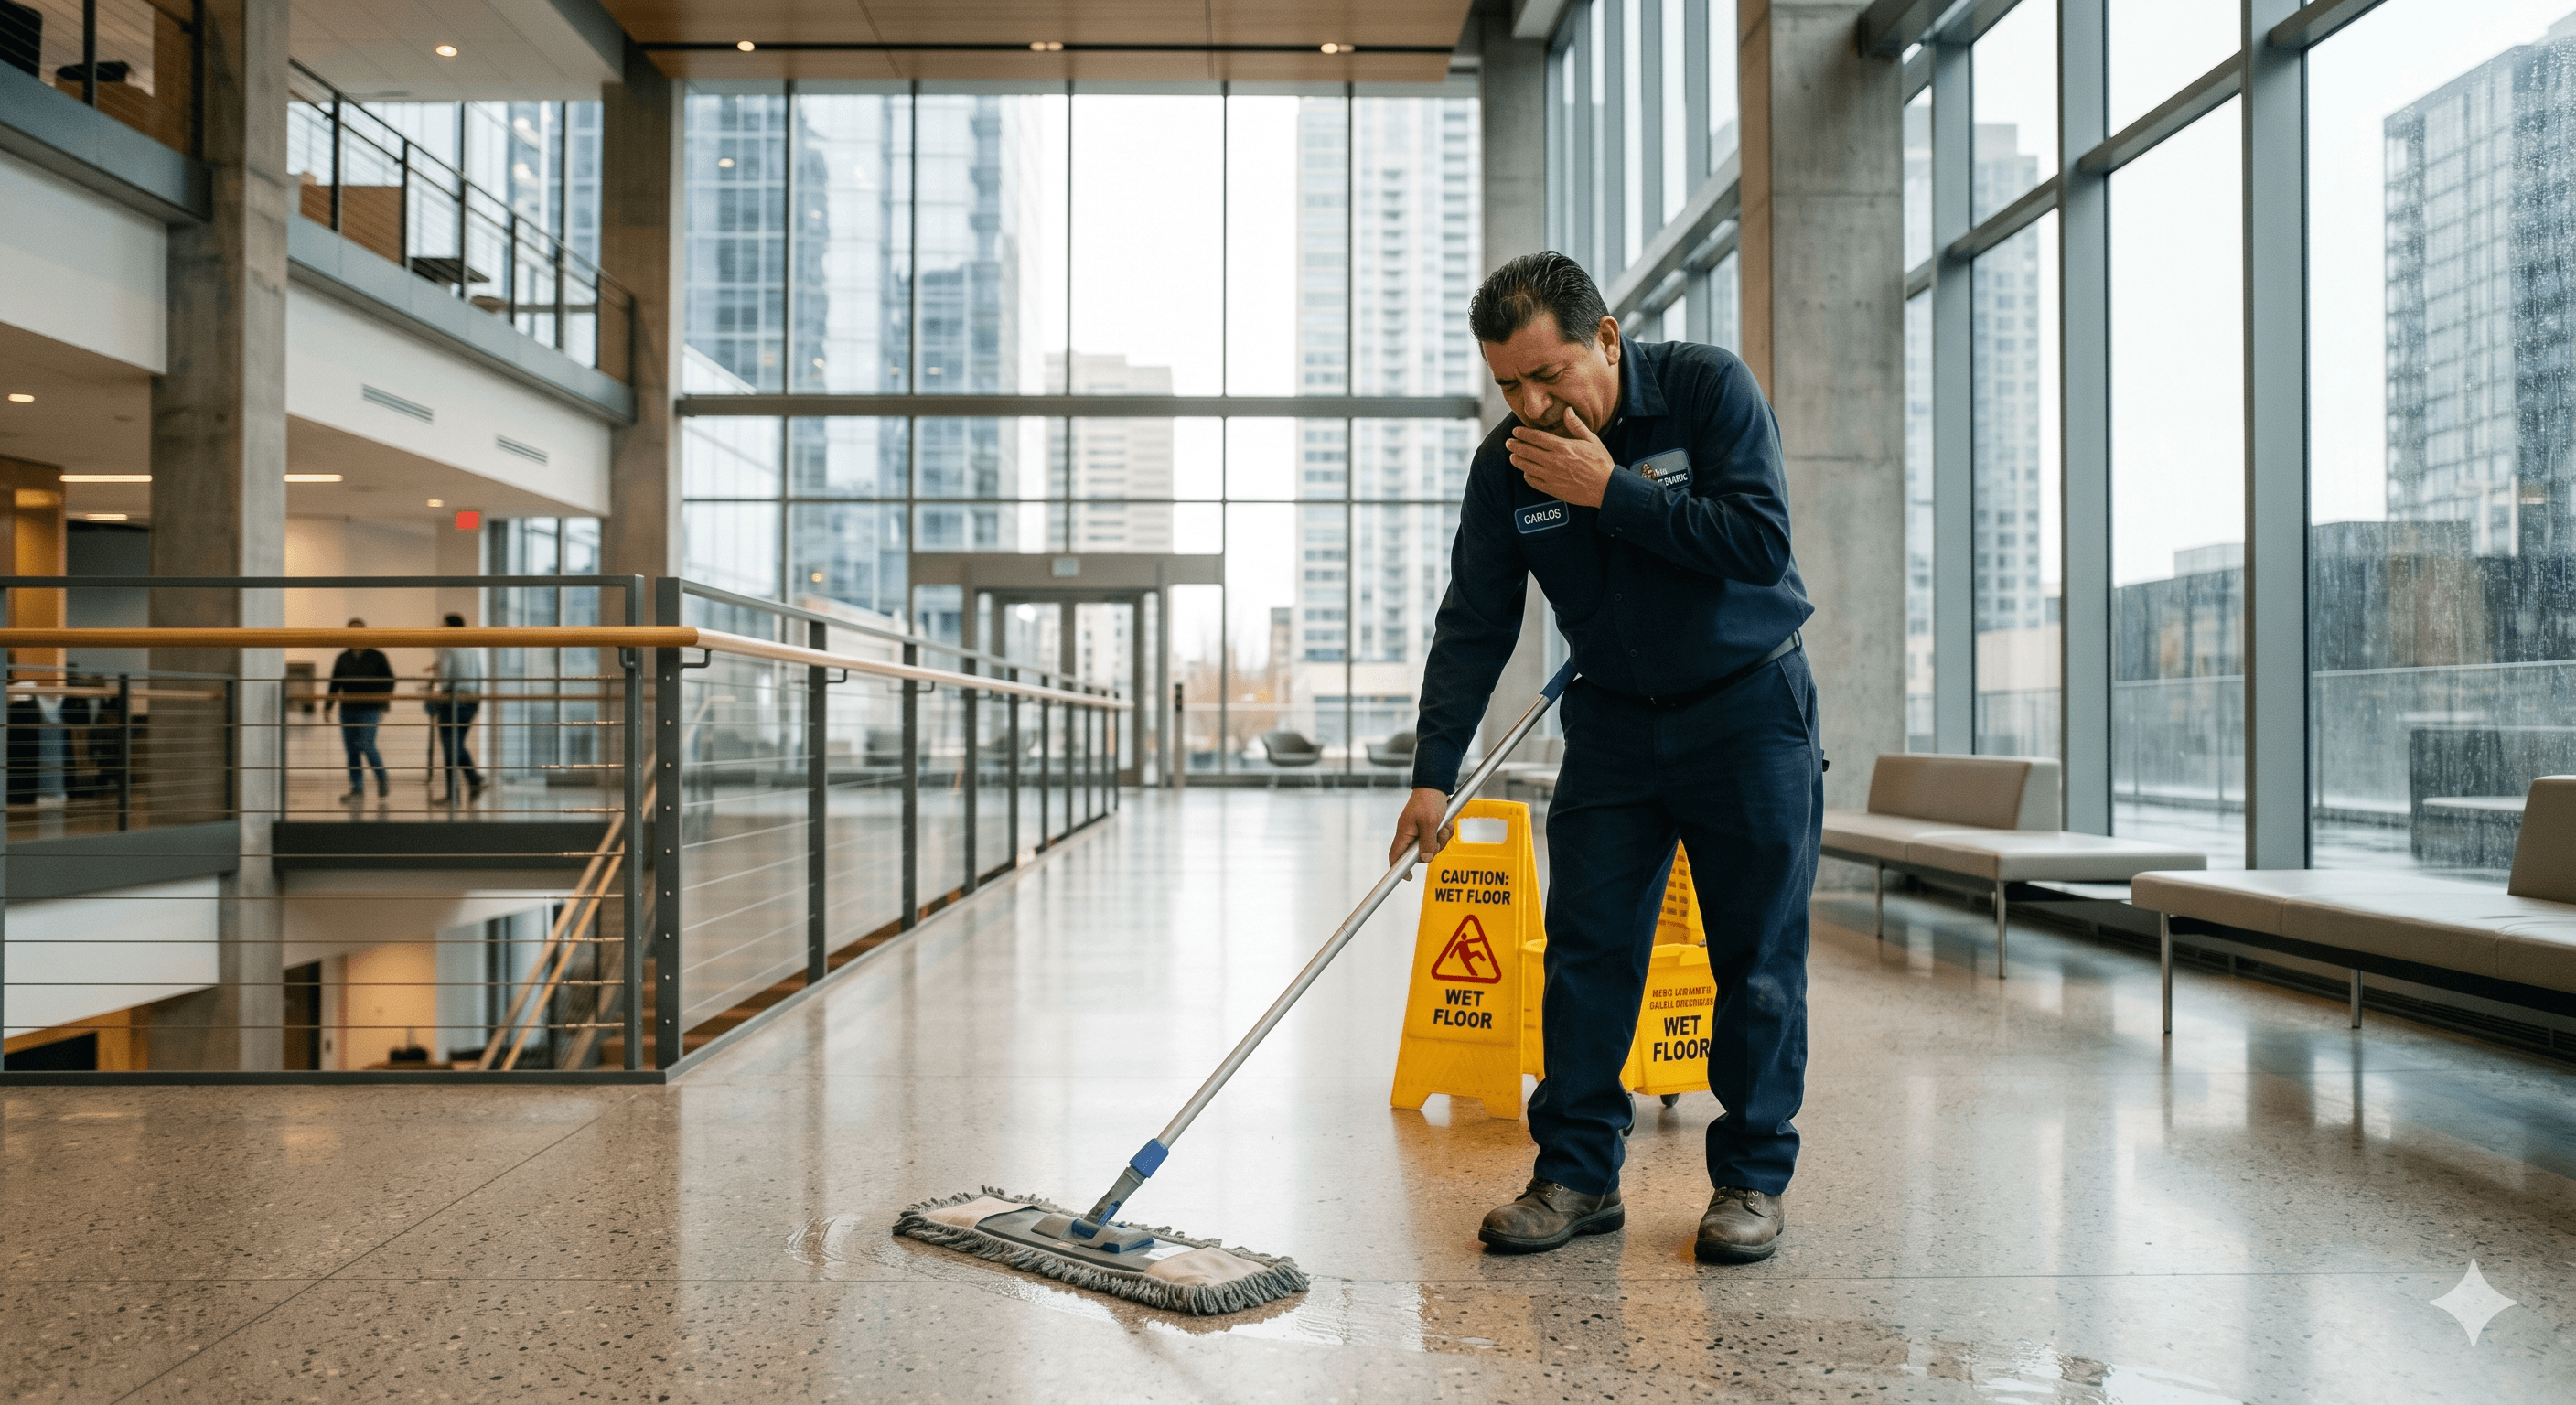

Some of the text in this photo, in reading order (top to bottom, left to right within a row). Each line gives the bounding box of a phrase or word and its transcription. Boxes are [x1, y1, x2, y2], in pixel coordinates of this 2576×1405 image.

[1523, 508, 1562, 525] CARLOS
[1440, 869, 1509, 885] CAUTION:
[1434, 887, 1511, 906] WET FLOOR
[1445, 988, 1485, 1007] WET
[1433, 1008, 1493, 1030] FLOOR
[1663, 1014, 1701, 1037] WET
[1653, 1038, 1710, 1062] FLOOR
